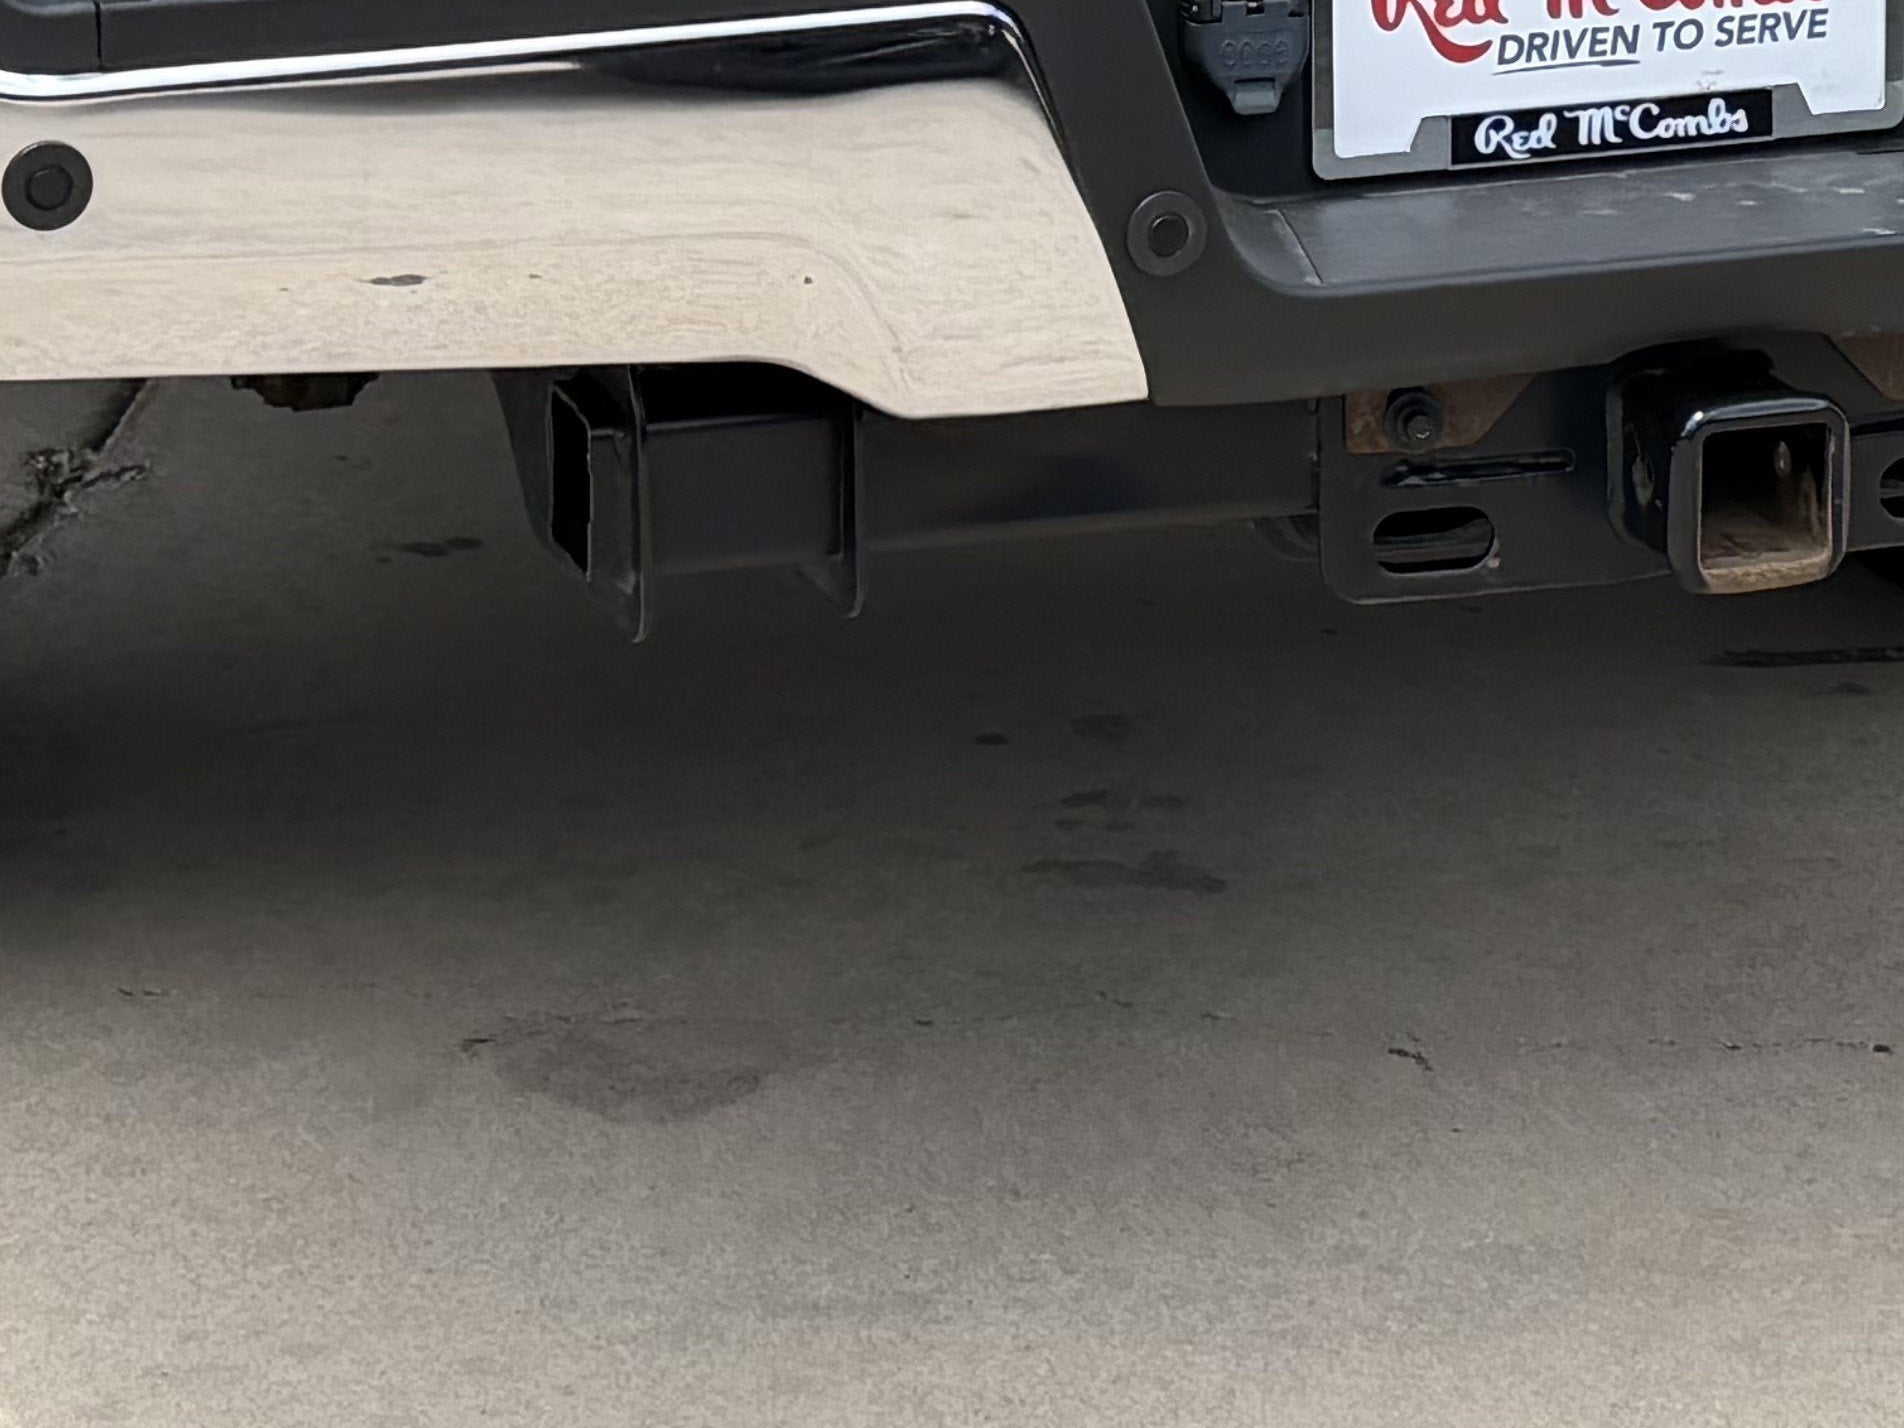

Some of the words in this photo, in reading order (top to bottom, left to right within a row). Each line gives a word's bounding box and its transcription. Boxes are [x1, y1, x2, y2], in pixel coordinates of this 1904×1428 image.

[1497, 23, 1640, 66] DRIVEN
[1652, 17, 1704, 52] TO
[1714, 7, 1830, 48] SERVE
[1474, 113, 1557, 160] Red
[1564, 97, 1750, 146] McCombs
